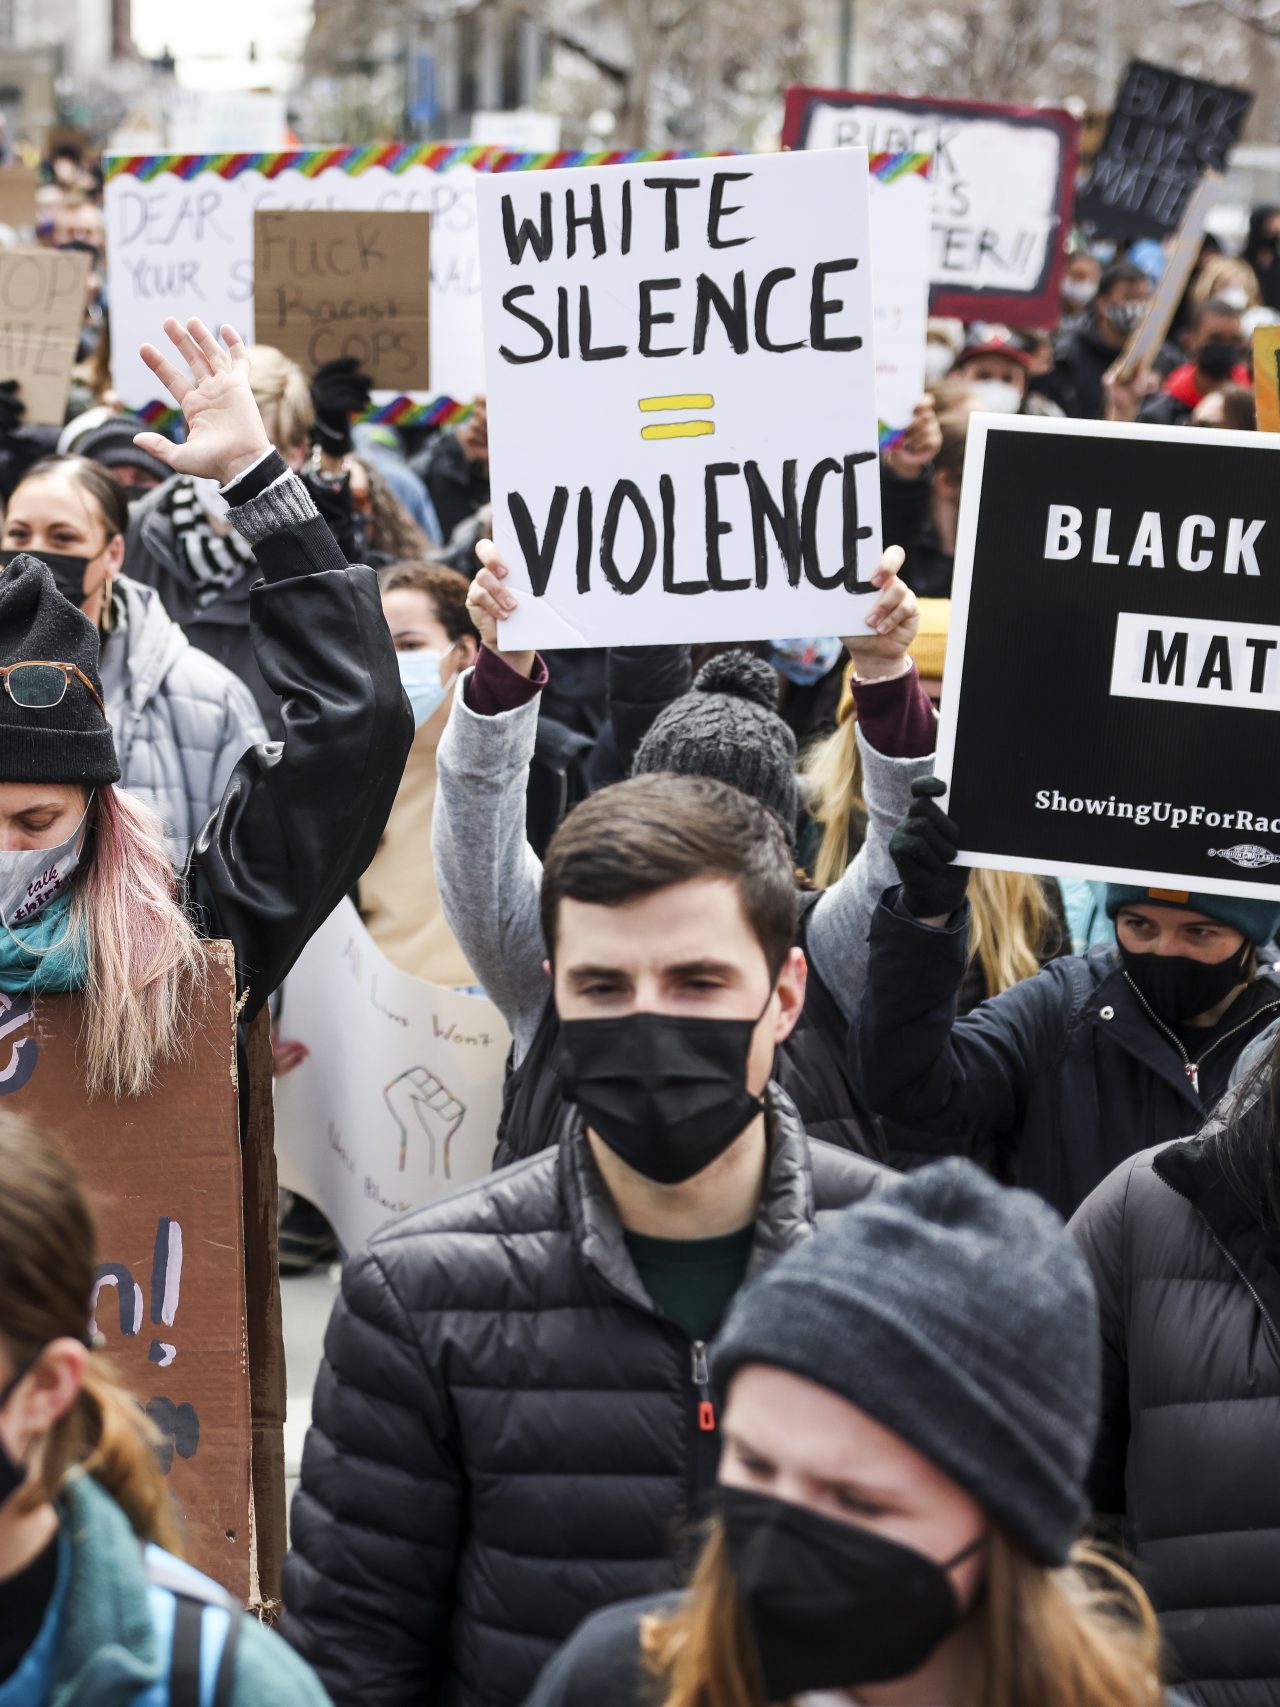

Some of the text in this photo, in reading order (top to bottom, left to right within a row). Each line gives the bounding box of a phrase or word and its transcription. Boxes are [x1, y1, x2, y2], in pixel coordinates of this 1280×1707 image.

[117, 189, 234, 248] DEAR
[501, 172, 757, 265] WHITE
[499, 258, 863, 365] SILENCE
[307, 327, 417, 374] COPS
[508, 452, 879, 598] VIOLENCE
[1043, 503, 1267, 577] BLACK
[1141, 629, 1279, 694] MAT
